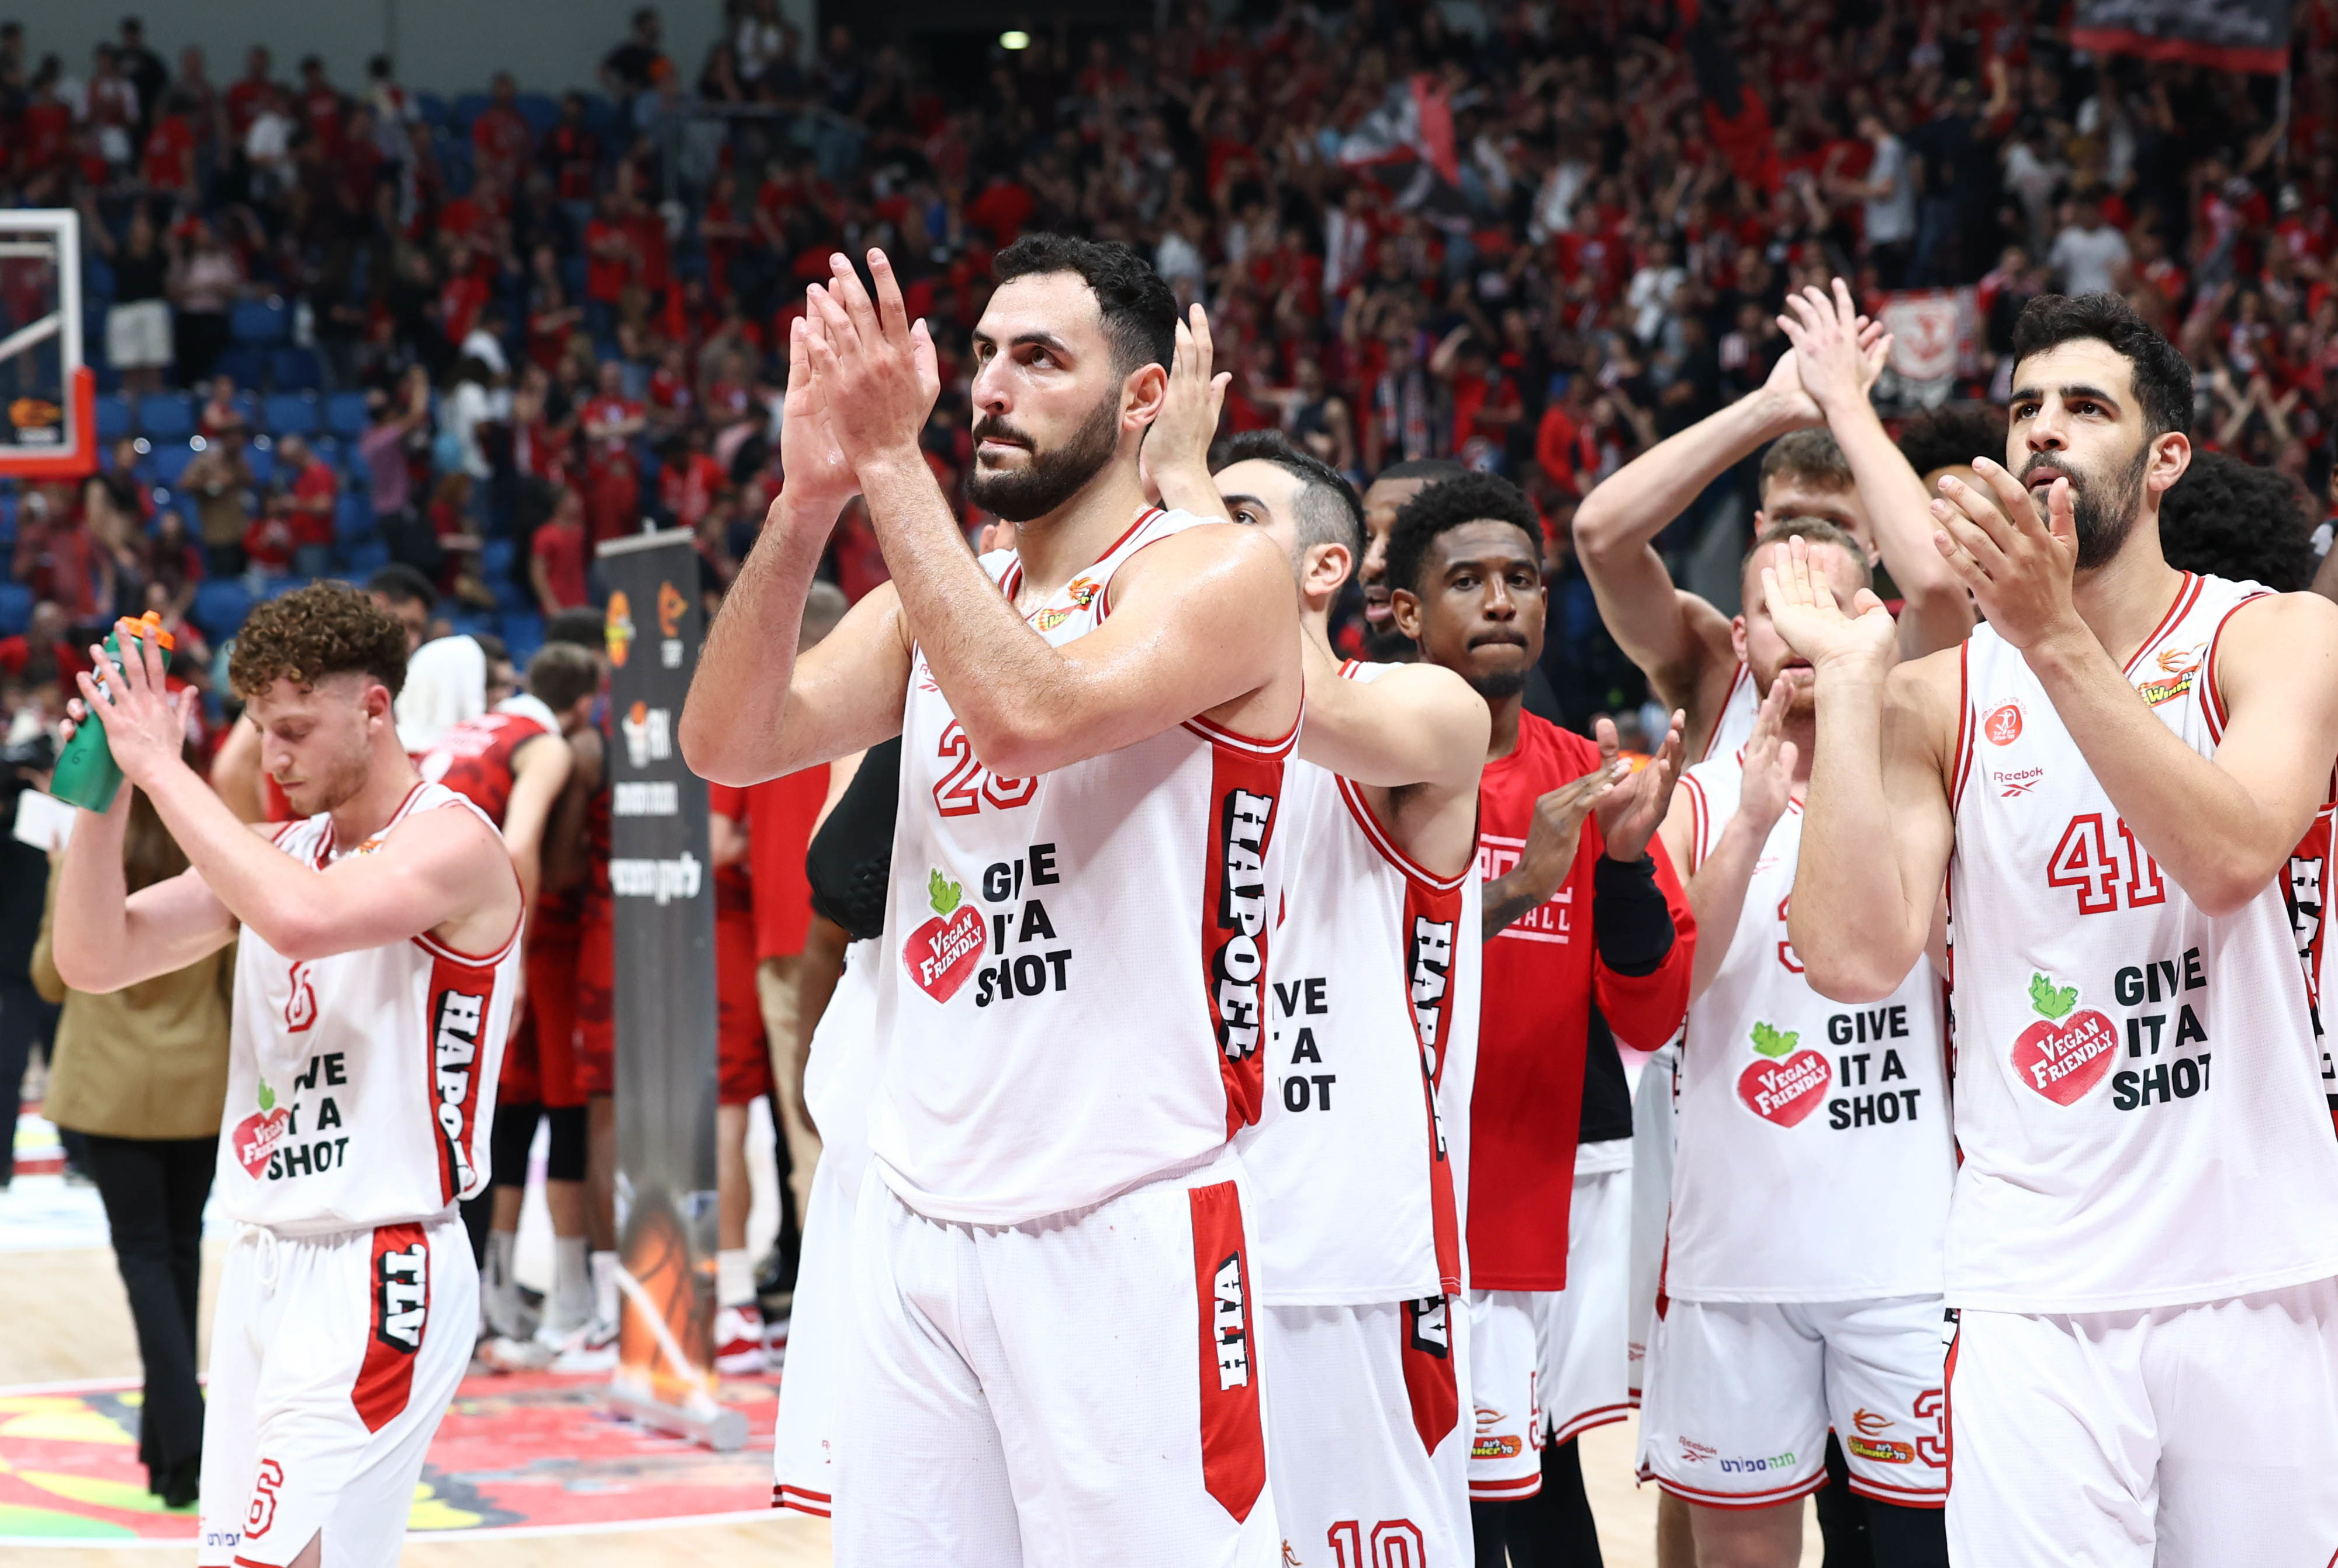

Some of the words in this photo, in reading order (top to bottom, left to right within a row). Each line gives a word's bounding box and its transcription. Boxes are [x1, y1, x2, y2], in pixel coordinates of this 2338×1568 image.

[1994, 767, 2043, 783] Reebok
[983, 843, 1060, 902] GIE
[928, 913, 973, 958] VEGAN
[1019, 899, 1057, 943] A
[920, 925, 983, 987] FRIENDLY
[2114, 946, 2207, 1006] GIVE
[1272, 977, 1328, 1018] VE
[1291, 1027, 1322, 1064] A
[1828, 1005, 1909, 1046] GIVE
[2036, 1017, 2100, 1062] VEGAN
[2126, 1014, 2166, 1058] IT
[2175, 1003, 2208, 1047] A
[1757, 1054, 1818, 1093] VEGAN
[1839, 1053, 1870, 1087] IT
[1880, 1048, 1907, 1082] A
[2030, 1030, 2113, 1089] FRIENDLY
[2112, 1050, 2212, 1111] SHOT
[1281, 1074, 1336, 1113] OT
[1754, 1065, 1828, 1116] FRIENDLY
[1828, 1088, 1921, 1130] SHOT
[317, 1097, 342, 1131] A
[268, 1136, 350, 1181] SHOT
[385, 1243, 427, 1347] TLV
[1679, 1435, 1717, 1455] Reebok
[243, 1458, 285, 1539] 6
